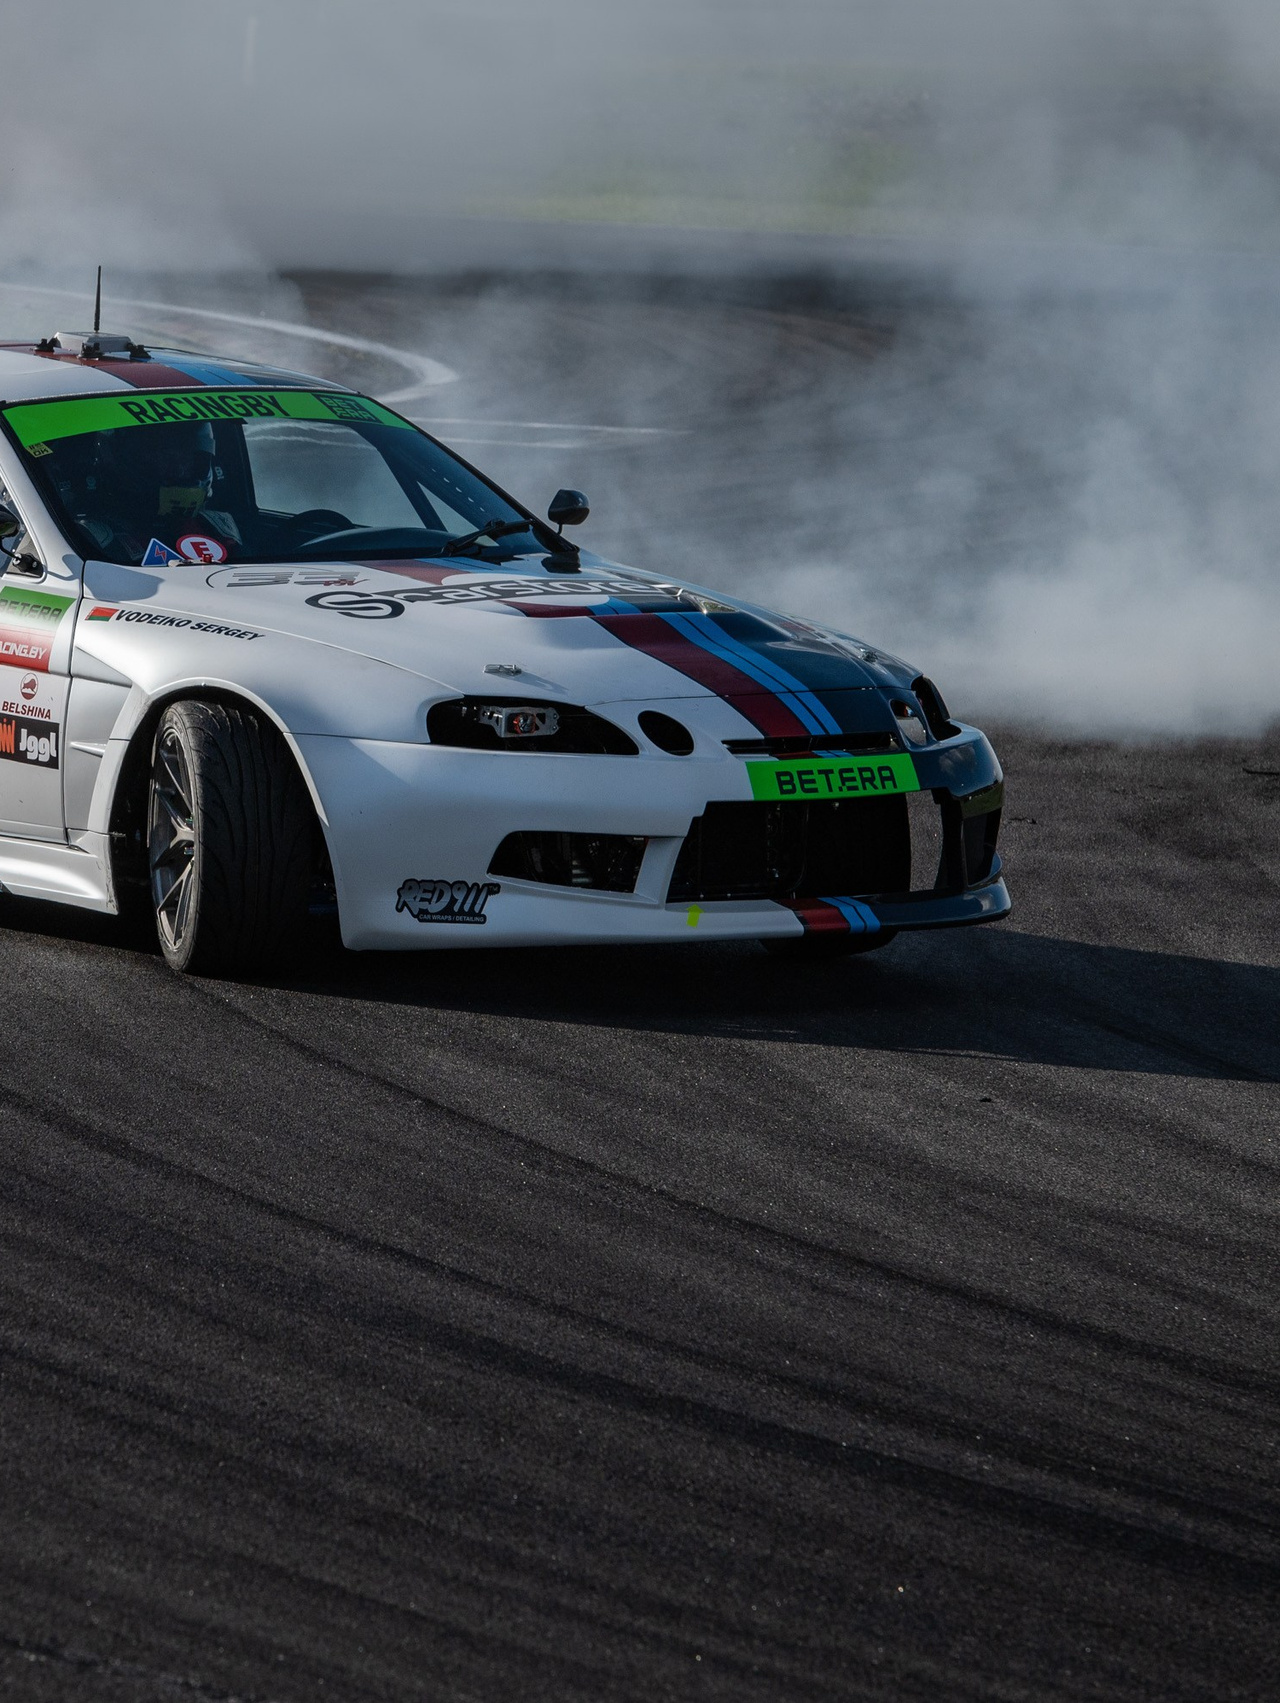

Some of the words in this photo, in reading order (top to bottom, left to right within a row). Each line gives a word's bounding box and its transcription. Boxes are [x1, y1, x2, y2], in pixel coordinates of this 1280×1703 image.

[119, 395, 290, 424] RACINGBY
[115, 609, 194, 628] VODEIKO
[190, 621, 266, 642] SERGEY
[2, 700, 52, 721] BELSHINA
